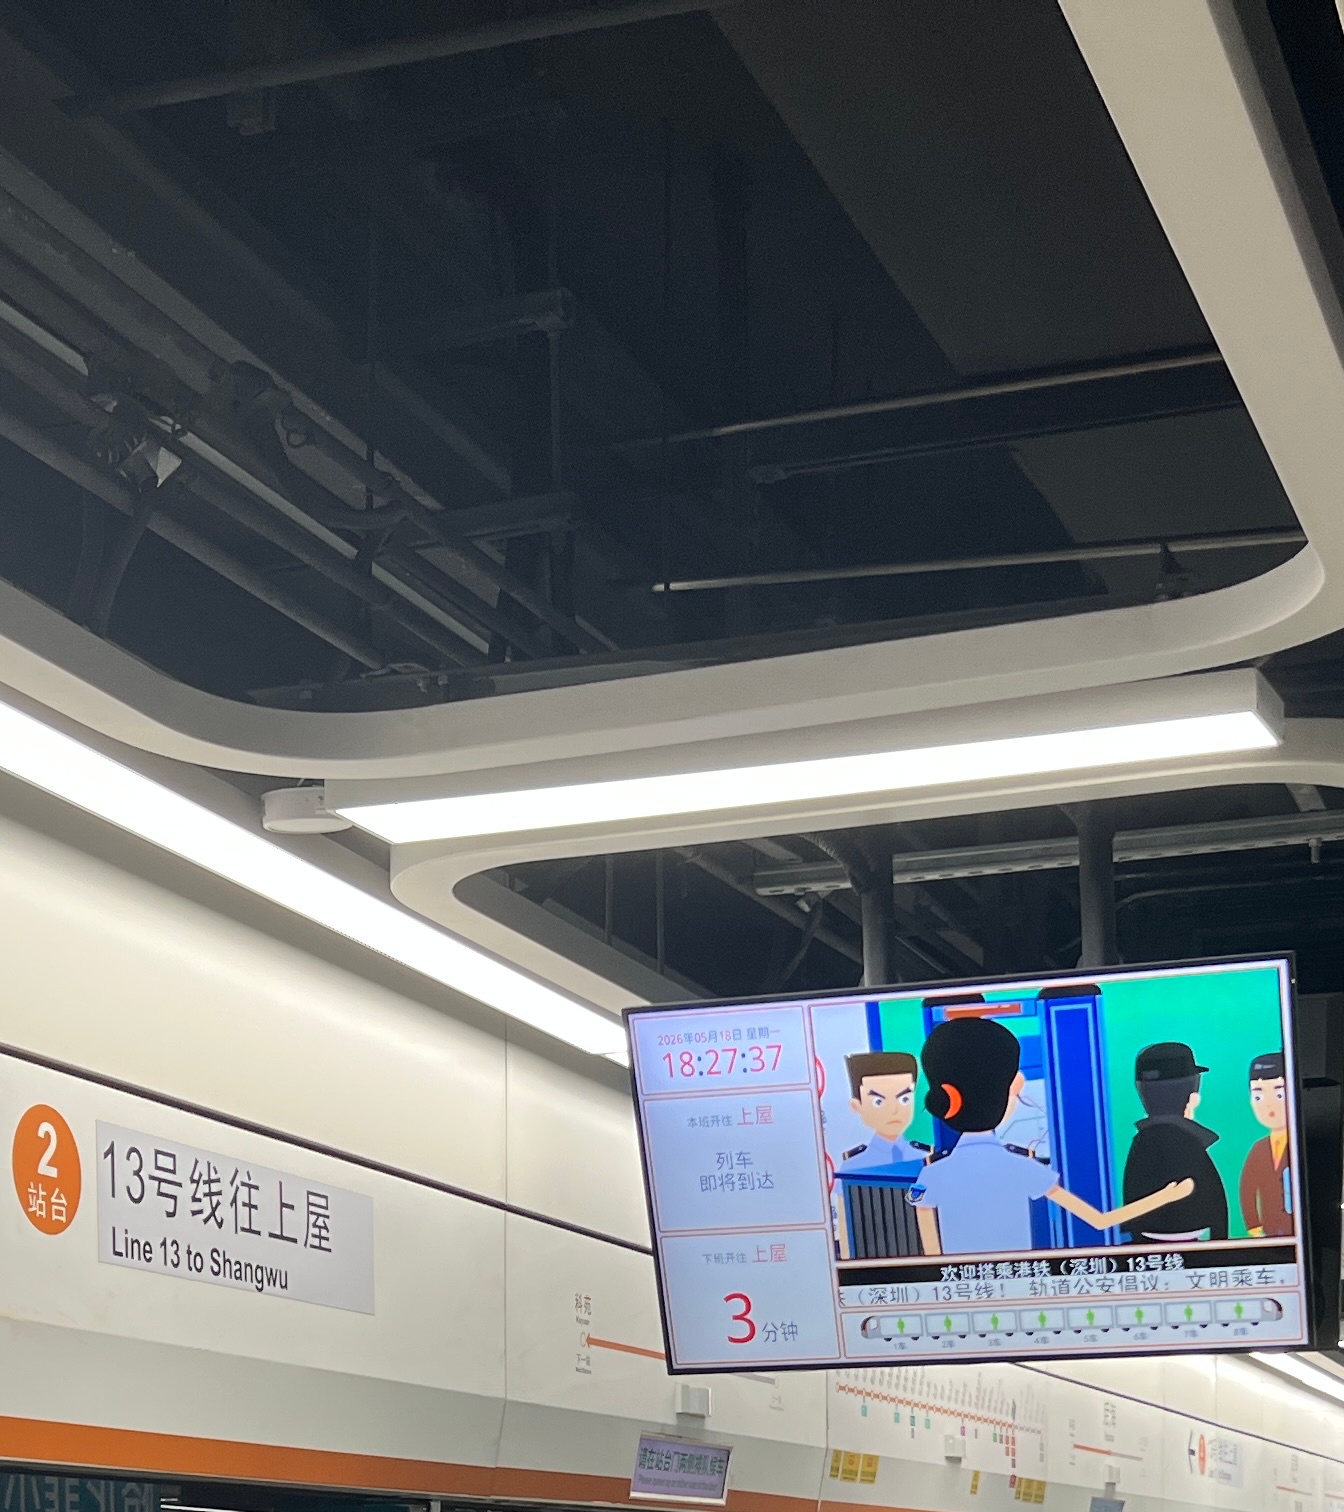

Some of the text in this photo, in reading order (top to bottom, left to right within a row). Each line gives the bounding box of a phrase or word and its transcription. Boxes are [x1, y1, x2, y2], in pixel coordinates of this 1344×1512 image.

[662, 1044, 782, 1078] 18:27:37
[737, 1105, 774, 1126] 上屋
[36, 1121, 58, 1178] 2
[716, 1150, 754, 1171] 列车
[102, 1140, 333, 1254] 13号线往上屋
[699, 1170, 775, 1193] 即将到达
[26, 1181, 69, 1224] 站台
[111, 1226, 289, 1293] Line 13 to Shangwu
[752, 1243, 788, 1264] 上屋
[723, 1291, 799, 1344] 3 分钟
